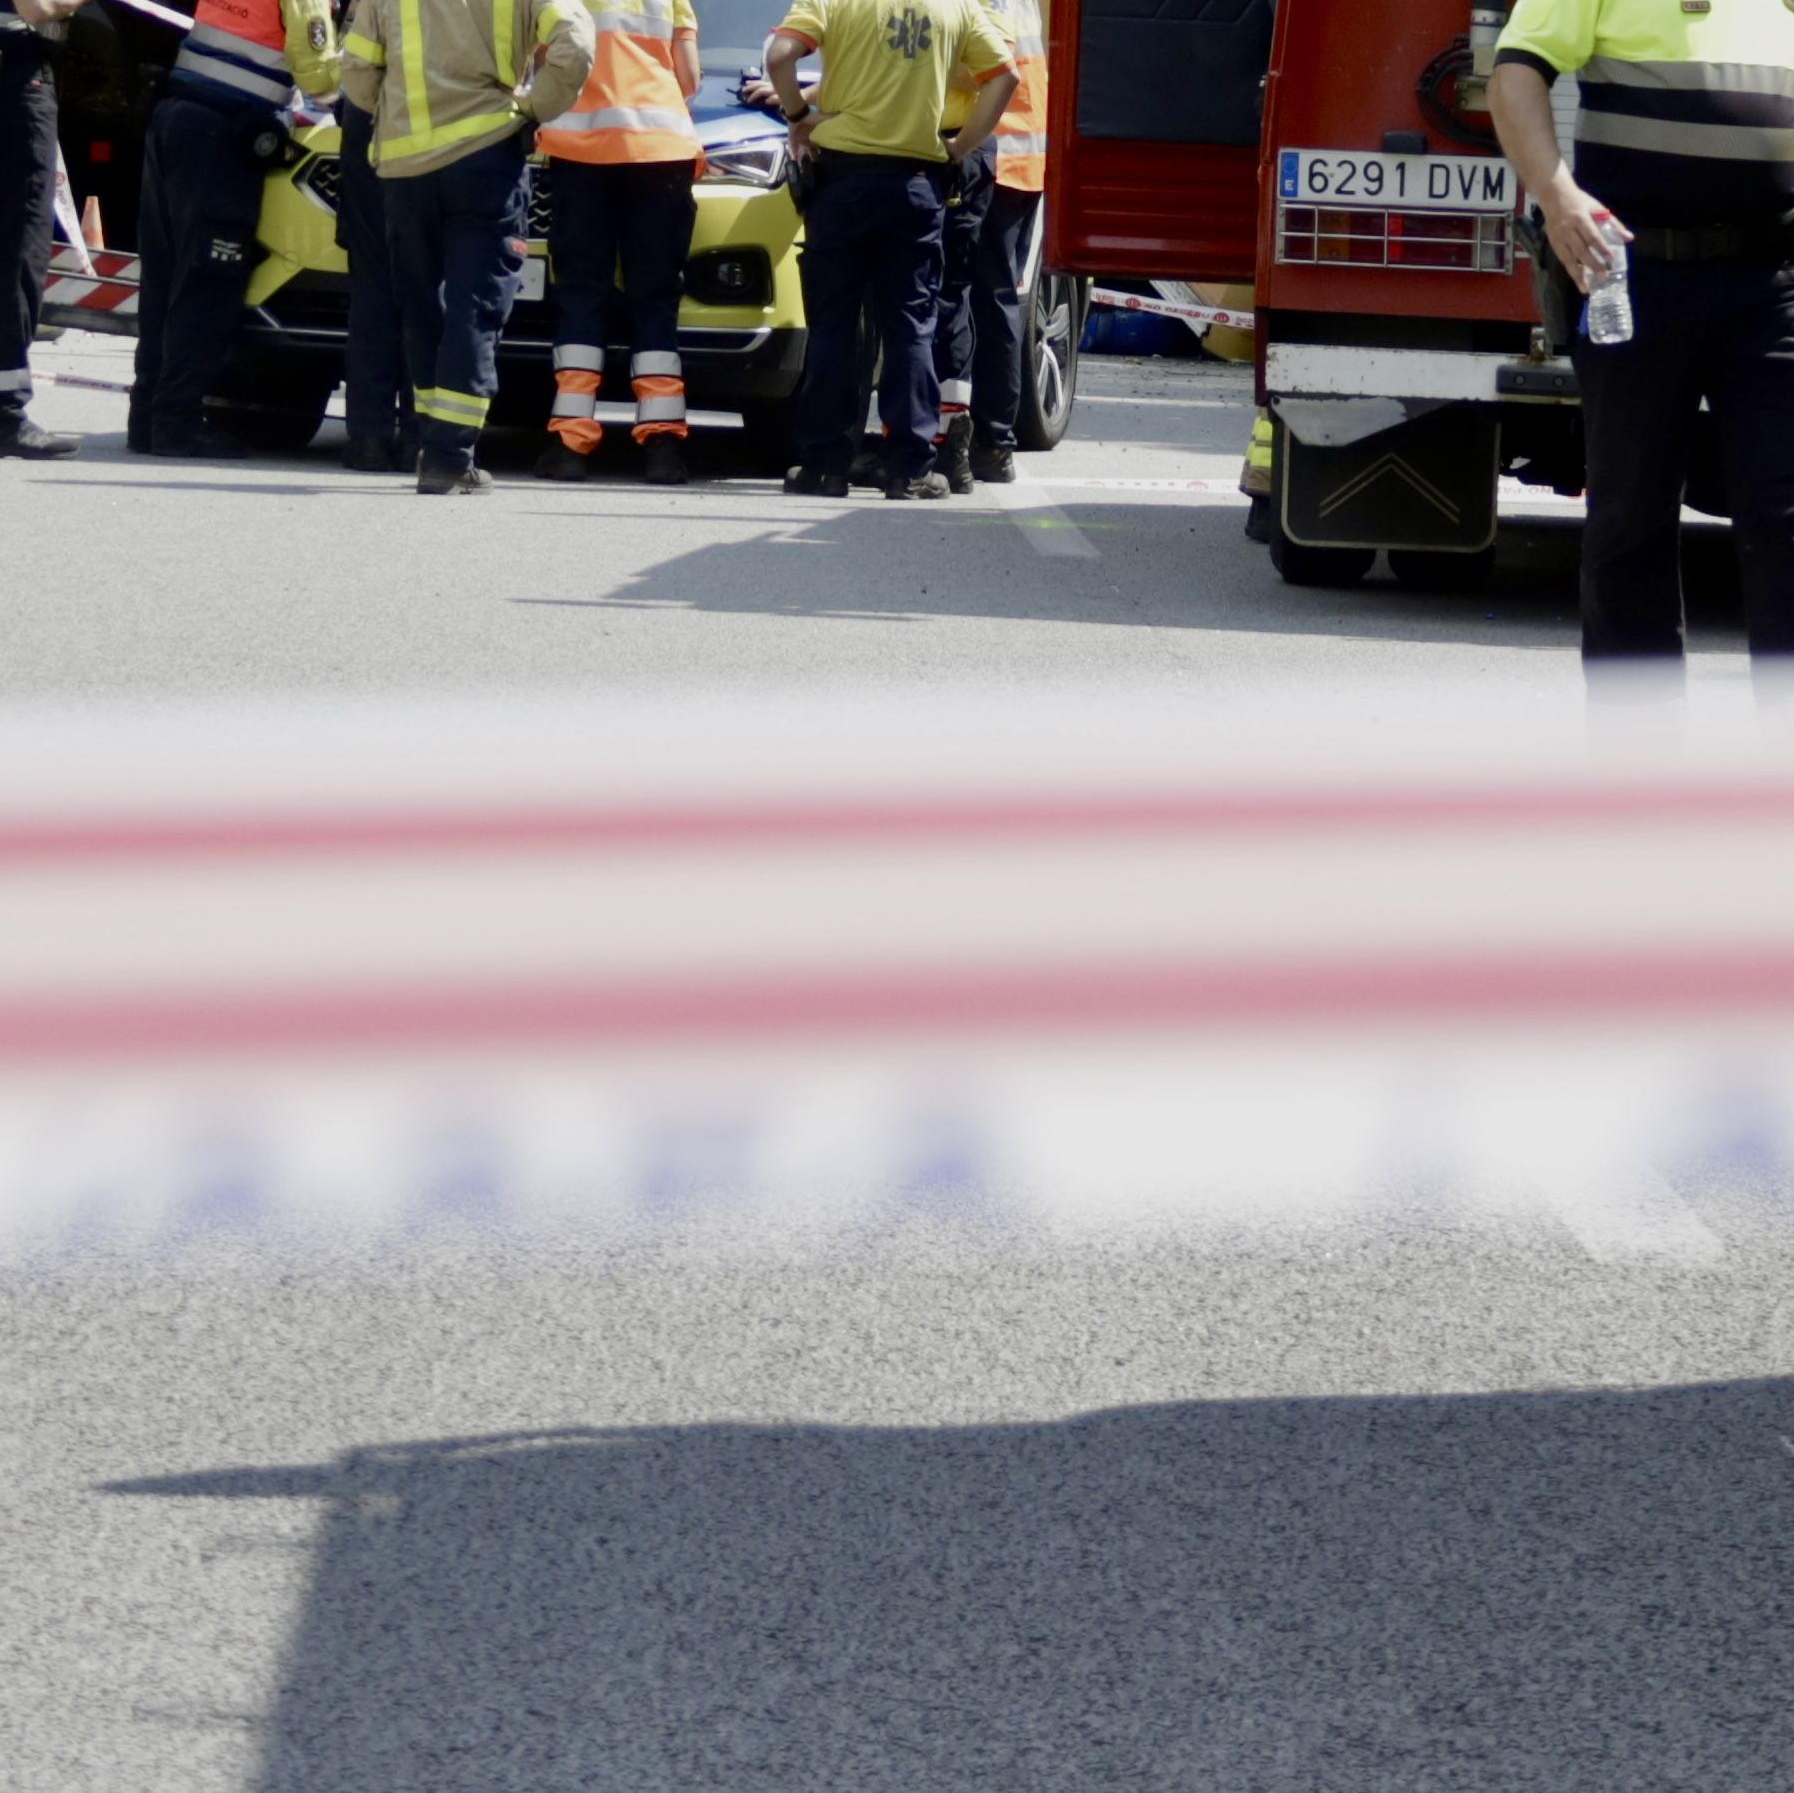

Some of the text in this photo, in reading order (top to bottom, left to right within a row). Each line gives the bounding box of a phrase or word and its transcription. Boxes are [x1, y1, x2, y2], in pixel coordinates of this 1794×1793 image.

[1284, 158, 1505, 202] E 6291 DVM
